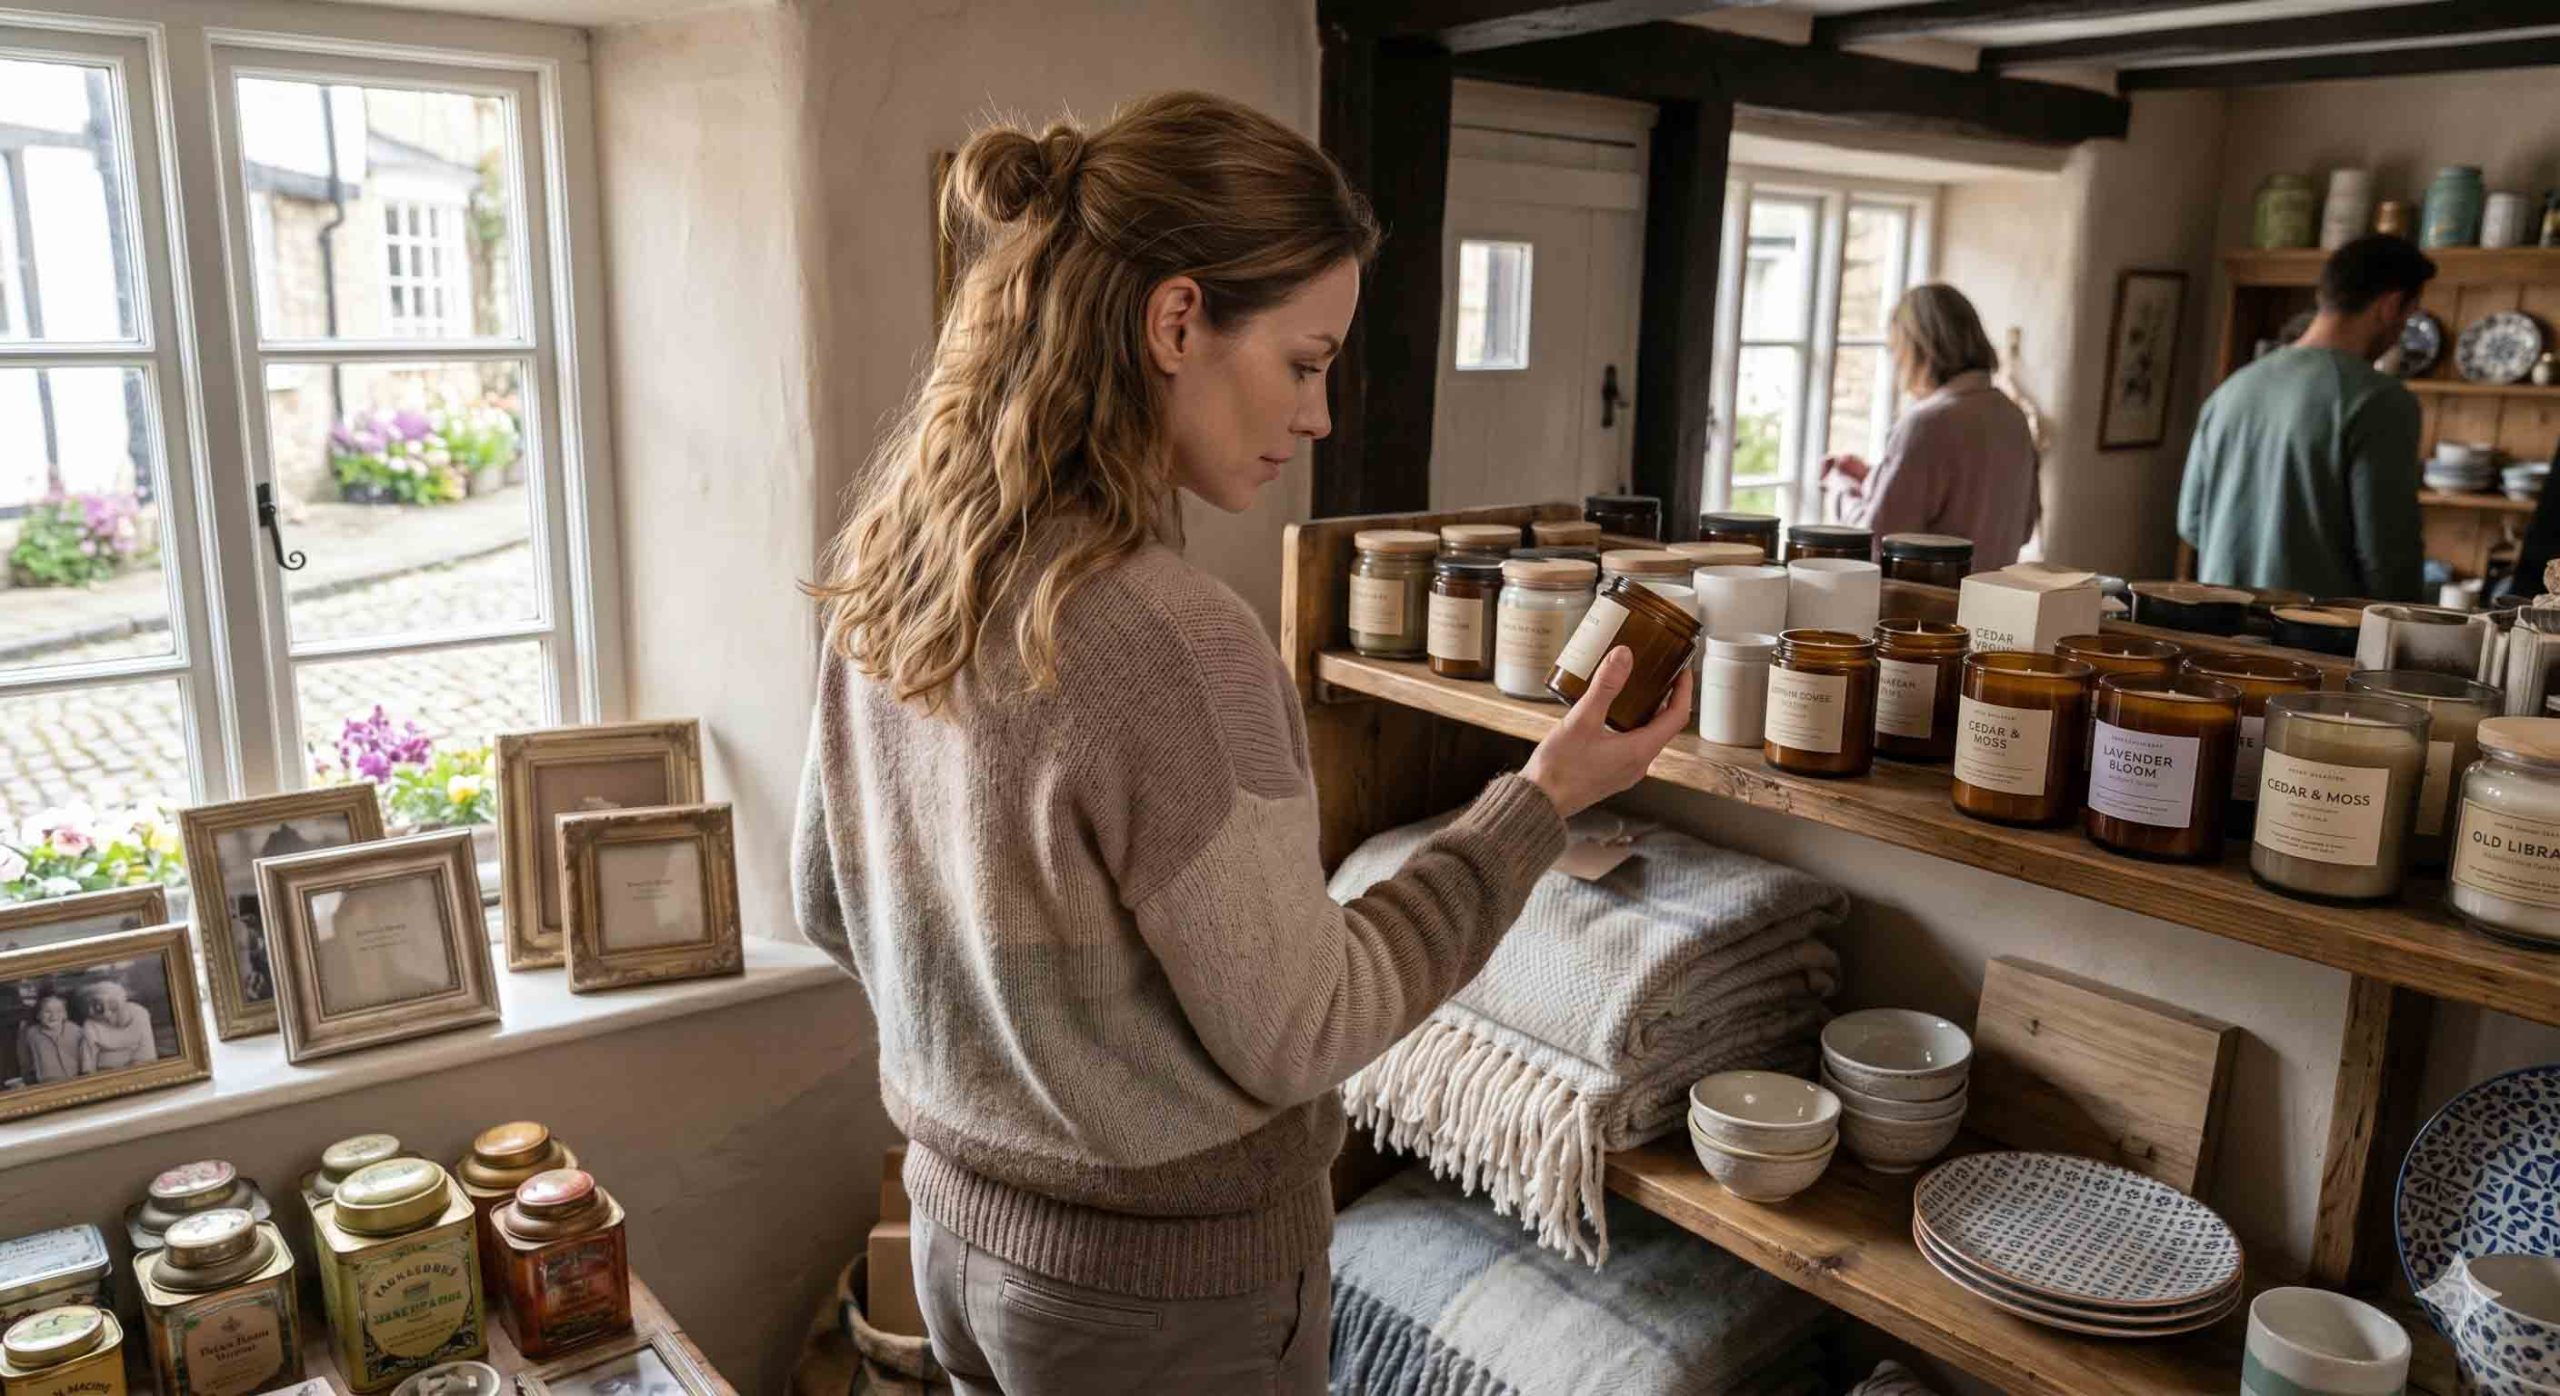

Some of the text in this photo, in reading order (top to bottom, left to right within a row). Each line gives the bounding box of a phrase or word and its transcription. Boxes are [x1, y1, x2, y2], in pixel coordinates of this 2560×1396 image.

[1975, 627, 2014, 645] CEDAR
[1968, 720, 2020, 739] CEDAR &
[1973, 734, 2007, 749] MOSS
[2103, 744, 2173, 768] LAVENDER
[2109, 759, 2157, 778] BLOOM
[2267, 777, 2371, 806] CEDAR & MOSS
[2472, 830, 2502, 848] OLD
